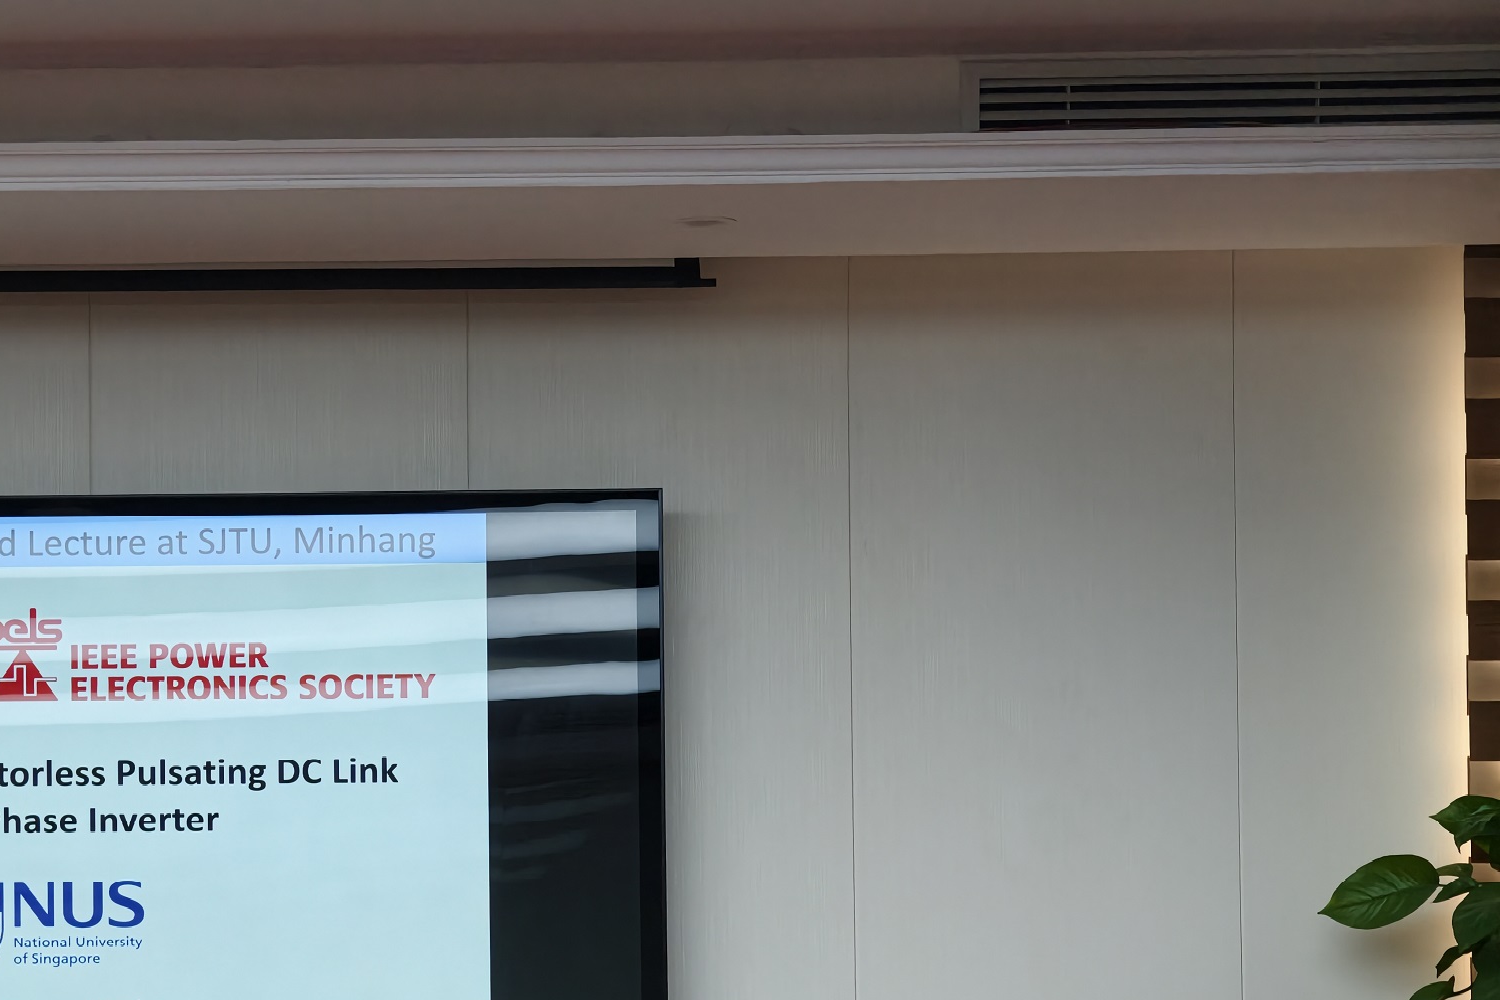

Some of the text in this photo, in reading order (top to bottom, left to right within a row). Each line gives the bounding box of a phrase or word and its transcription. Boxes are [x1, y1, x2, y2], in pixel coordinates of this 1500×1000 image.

[28, 530, 147, 557] Lecture
[157, 531, 188, 556] at
[198, 527, 282, 560] SJTU,
[294, 525, 436, 560] Minhang
[70, 642, 270, 670] IEEE POWER
[70, 673, 437, 702] ELECTRONICS SOCIETY
[117, 758, 267, 792] Pulsating
[277, 758, 322, 784] DC
[333, 755, 399, 784] Link
[89, 807, 220, 834] Inverter
[13, 880, 145, 929] NUS
[13, 935, 143, 951] National University
[13, 951, 101, 968] of Singapore
